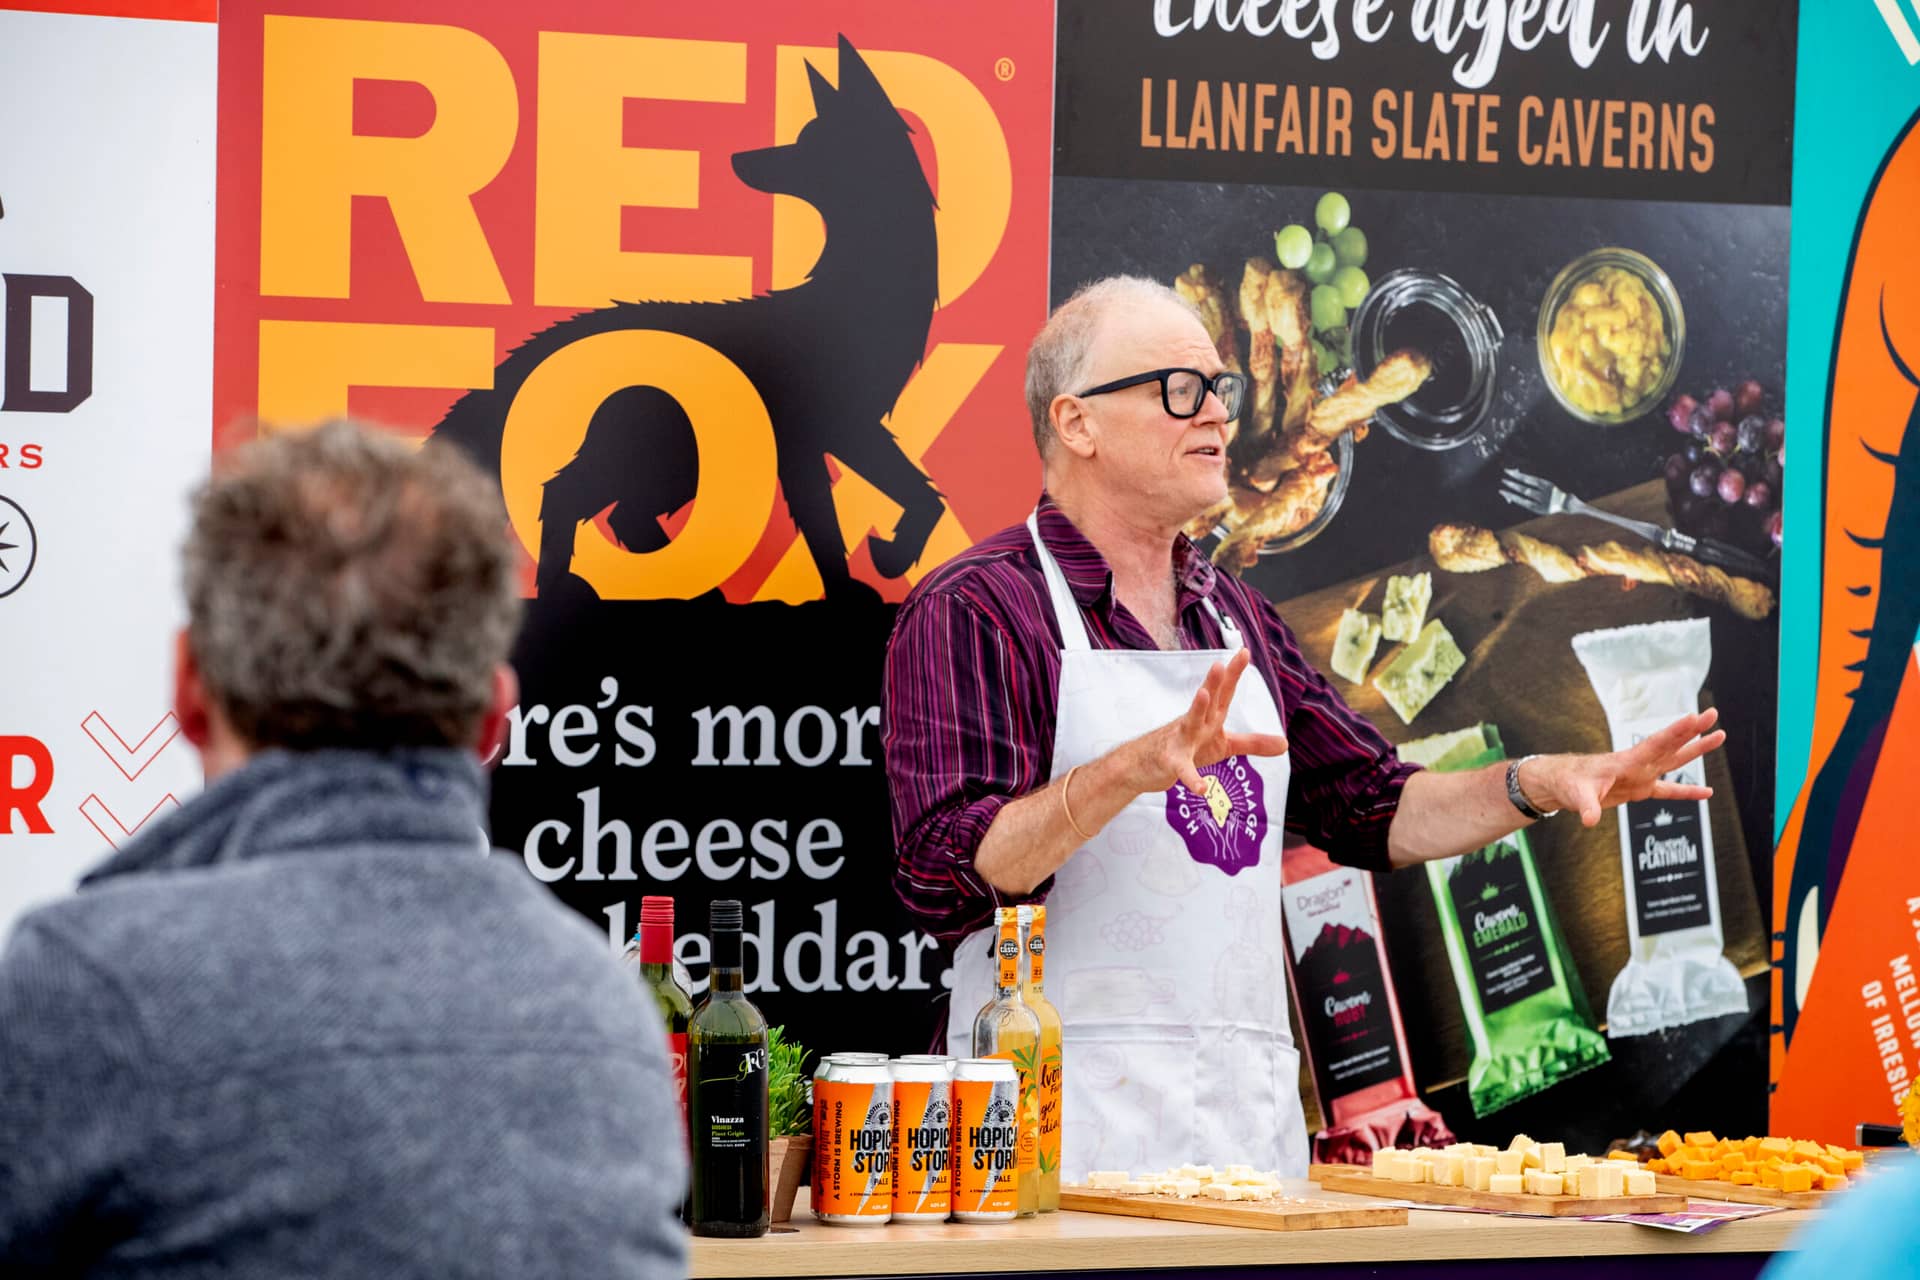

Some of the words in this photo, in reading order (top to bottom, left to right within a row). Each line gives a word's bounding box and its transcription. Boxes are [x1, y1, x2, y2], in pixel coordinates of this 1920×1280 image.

[1141, 77, 1353, 157] LLANFAIR
[1371, 87, 1501, 163] SLATE
[1517, 95, 1716, 173] CAVERNS
[260, 14, 1012, 310] RED
[691, 704, 881, 768] mor
[1175, 784, 1199, 836] HOM
[1227, 755, 1258, 841] ROMAGE
[523, 786, 846, 883] cheese
[1638, 844, 1698, 872] PLATINUM
[602, 898, 957, 994] eddar.
[1472, 911, 1529, 949] EMERALD
[1861, 980, 1887, 1009] OF
[1871, 1013, 1912, 1114] IRRESIS
[834, 1100, 843, 1145] BREWING
[892, 1099, 900, 1144] BREWING
[834, 1148, 841, 1156] IS
[850, 1129, 892, 1151] HOPIC
[892, 1146, 899, 1155] IS
[907, 1127, 951, 1149] HOPIC
[955, 1145, 962, 1153] IS
[833, 1158, 841, 1191] STORM
[854, 1152, 892, 1174] STOR
[891, 1157, 899, 1189] STORM
[993, 1174, 1011, 1183] PALE
[874, 1177, 888, 1186] PALE
[932, 1175, 947, 1184] PALE
